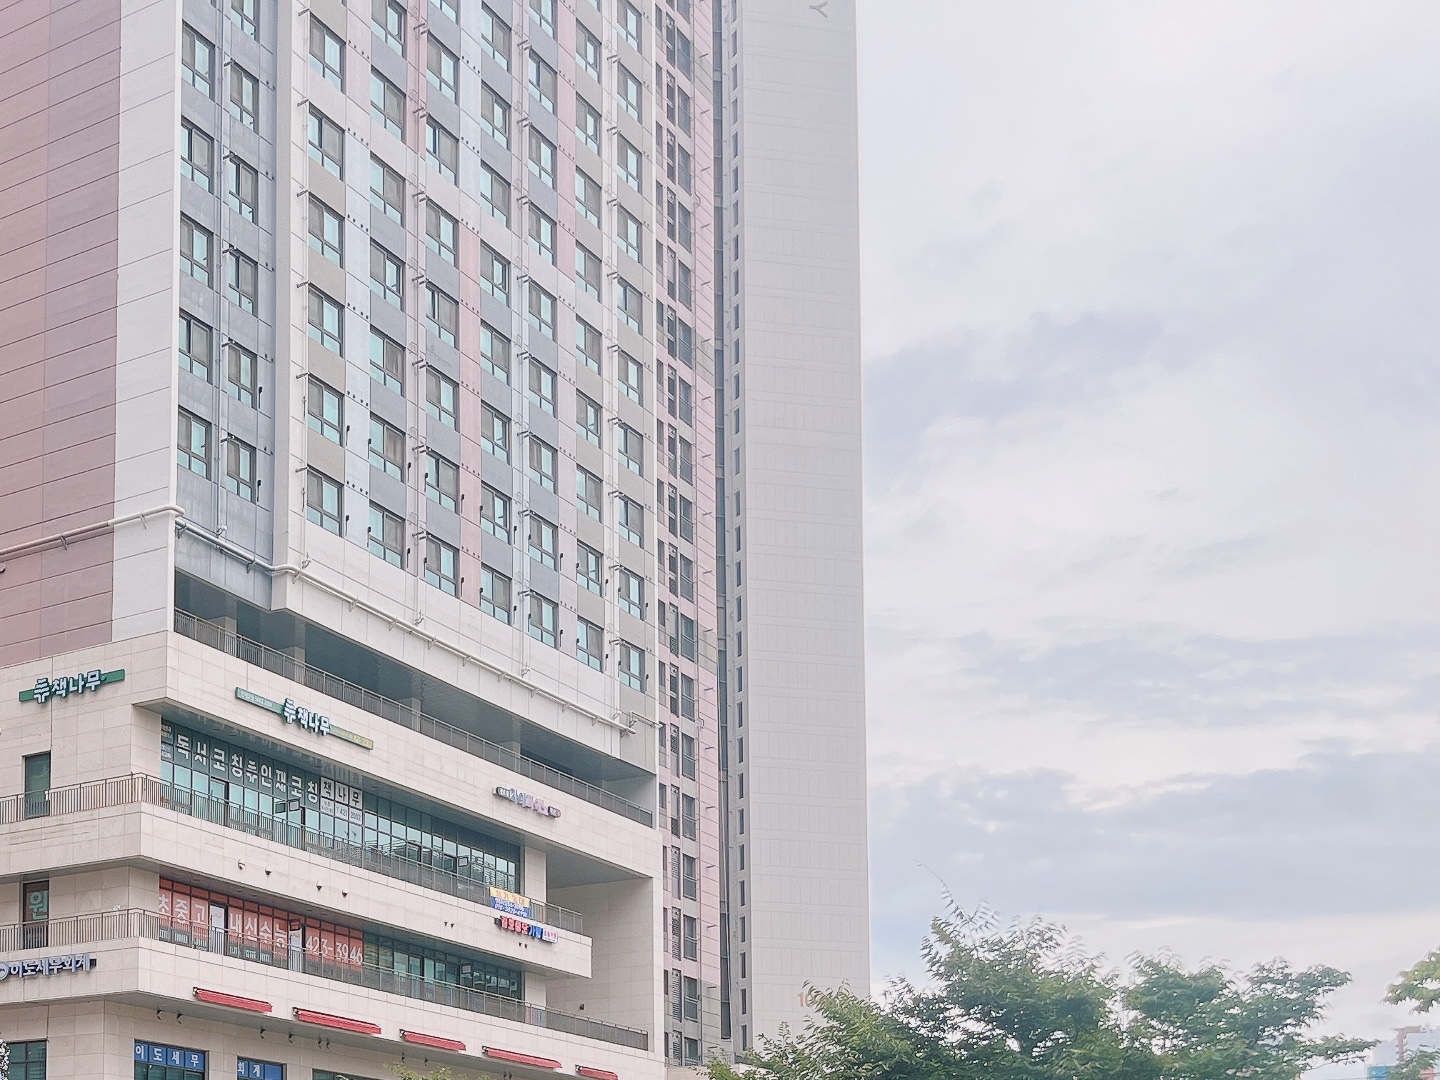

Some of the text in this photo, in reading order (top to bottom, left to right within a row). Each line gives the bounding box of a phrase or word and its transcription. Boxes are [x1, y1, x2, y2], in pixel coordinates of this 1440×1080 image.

[51, 669, 101, 698] 책나무
[297, 706, 331, 736] 책나무
[176, 734, 243, 778] 독서코칭
[260, 764, 319, 804] 인재코칭
[230, 911, 288, 948] 내신수능
[306, 935, 364, 965] 423-3946
[10, 953, 91, 978] 이도세무회계
[135, 1045, 261, 1077] 이도세무 회계
